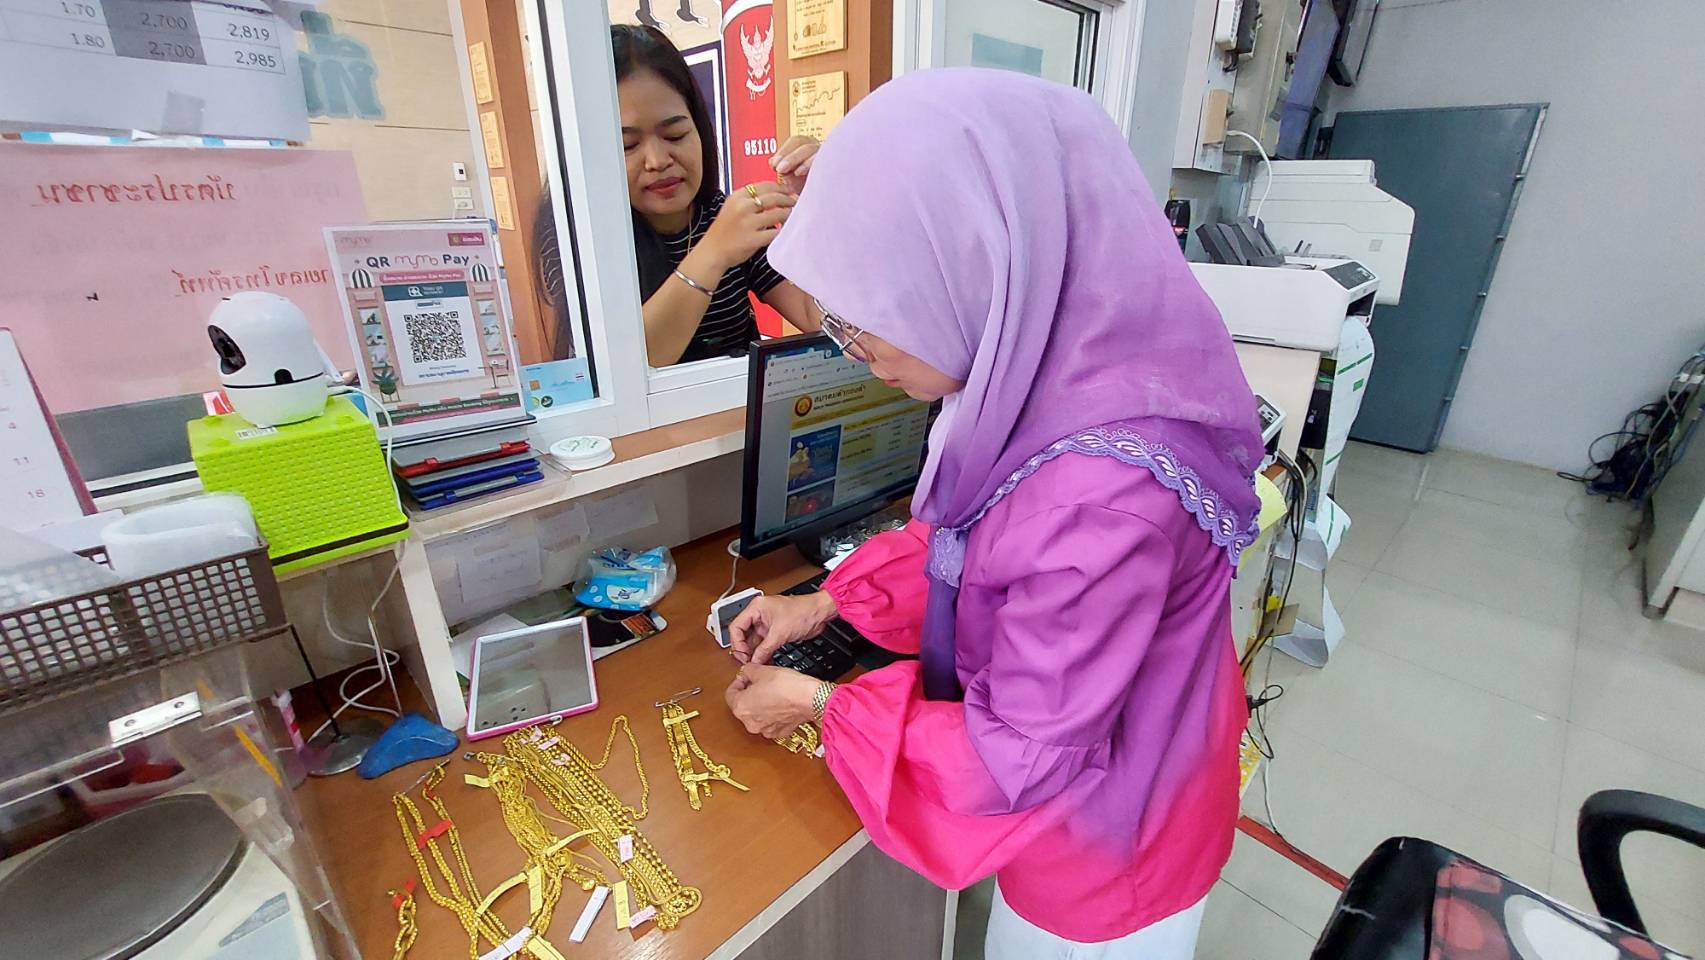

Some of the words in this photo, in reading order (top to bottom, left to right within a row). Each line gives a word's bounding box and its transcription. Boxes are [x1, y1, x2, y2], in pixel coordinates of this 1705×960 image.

[61, 1, 96, 18] 1.70
[228, 23, 270, 42] 2,819
[71, 32, 105, 49] 1.80
[149, 41, 196, 60] 2,700
[235, 51, 278, 69] 2,985
[744, 137, 777, 156] 95110
[366, 256, 390, 269] QR
[443, 254, 470, 267] Pay
